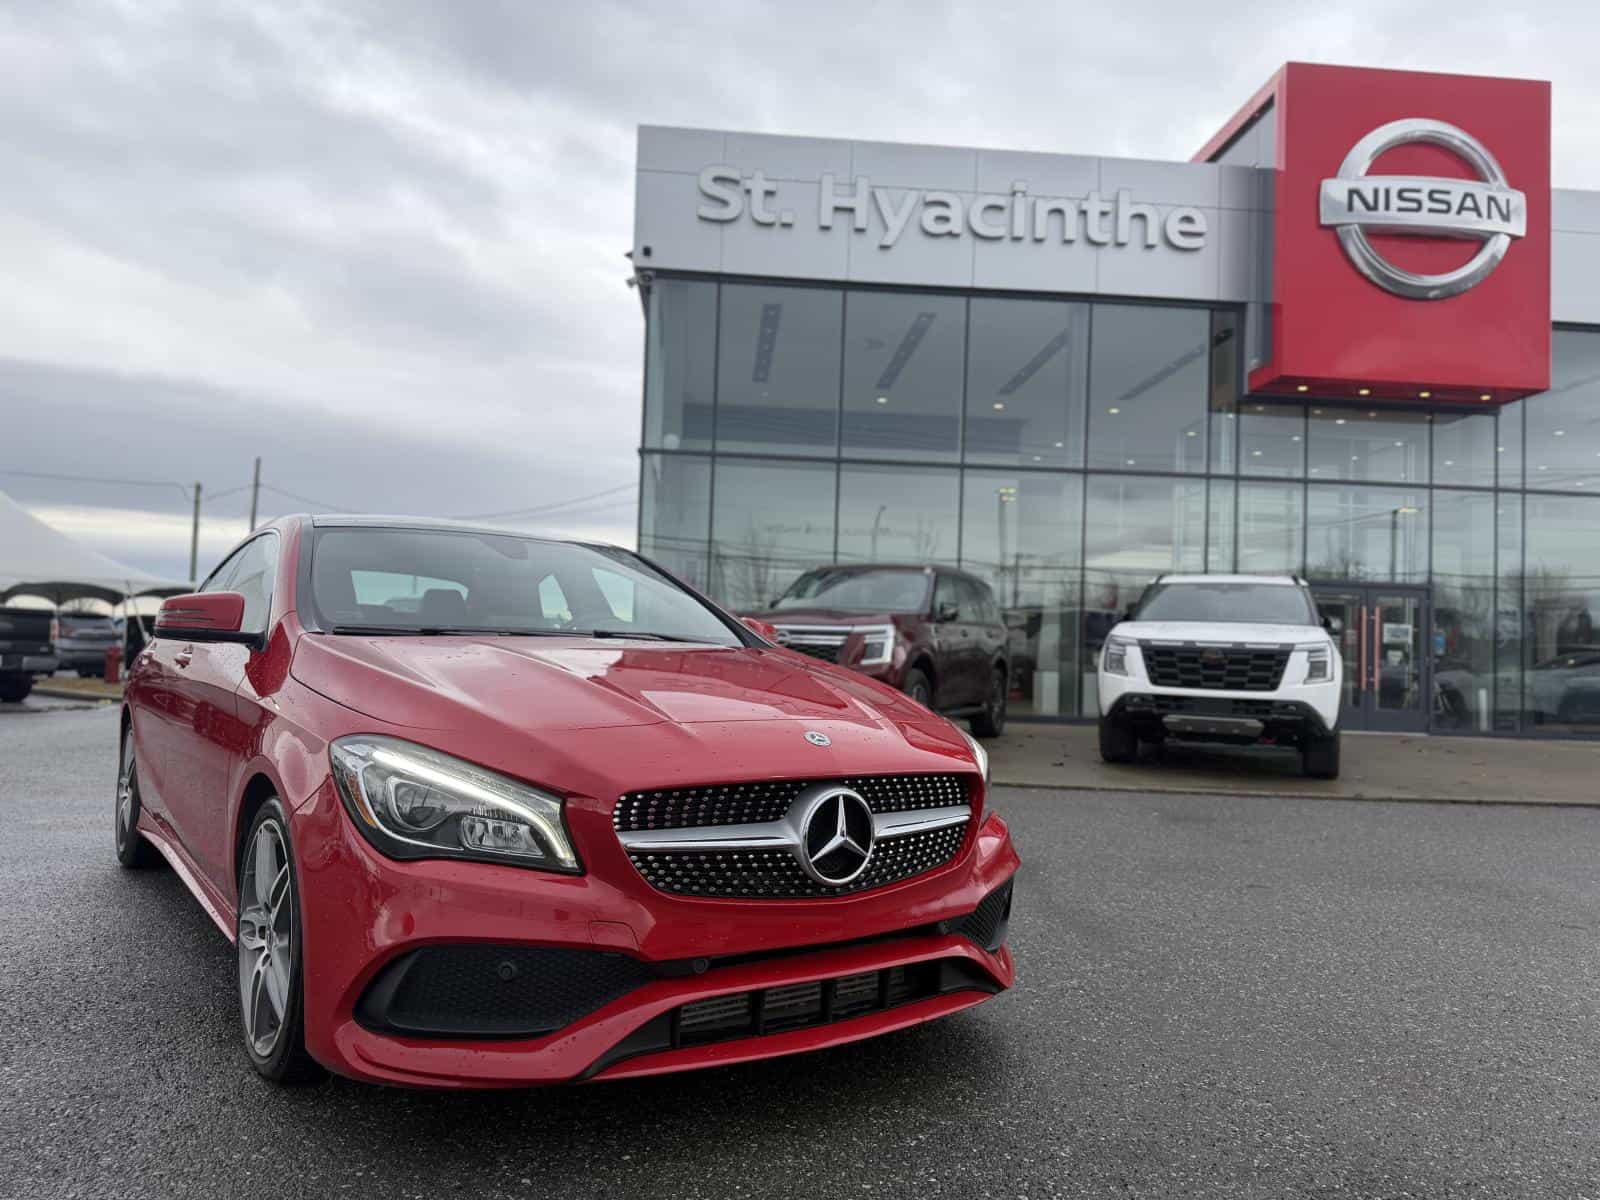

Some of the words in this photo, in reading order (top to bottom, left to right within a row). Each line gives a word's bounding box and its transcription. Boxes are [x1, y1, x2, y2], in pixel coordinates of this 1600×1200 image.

[697, 166, 793, 226] St.
[818, 174, 1208, 251] Hyacinthe
[1346, 188, 1511, 222] NISSAN
